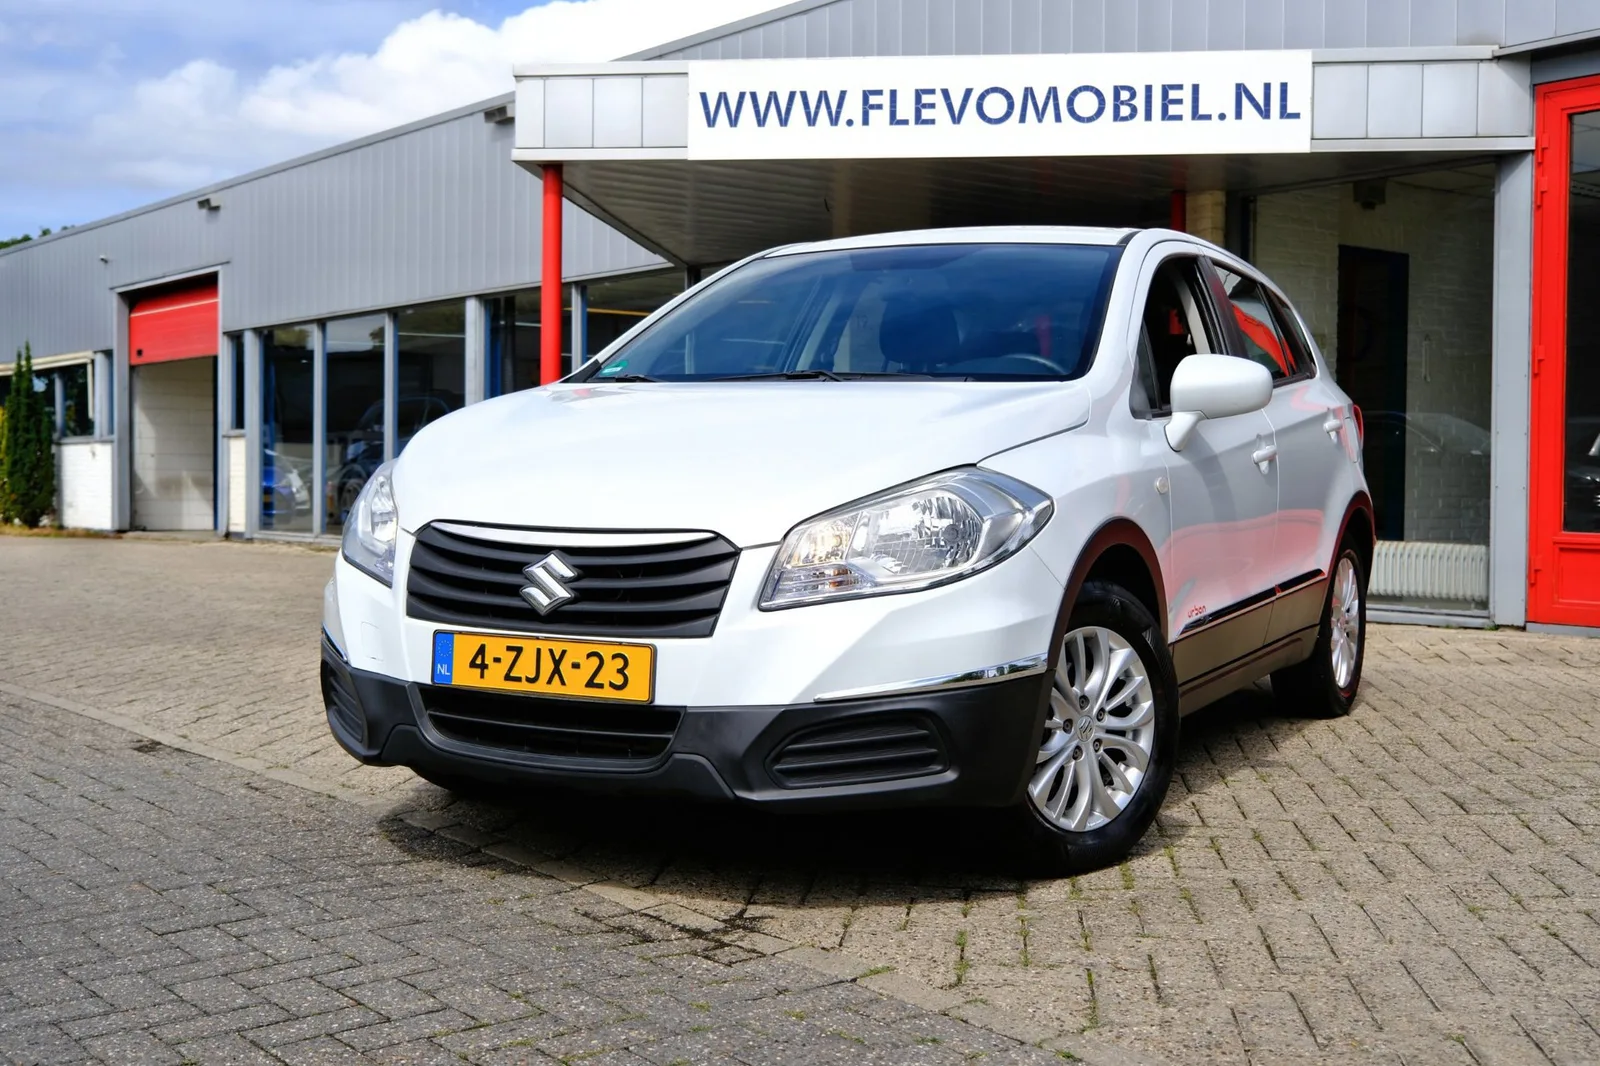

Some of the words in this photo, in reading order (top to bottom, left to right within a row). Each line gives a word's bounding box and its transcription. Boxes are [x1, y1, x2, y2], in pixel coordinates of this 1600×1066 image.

[699, 82, 1301, 128] WWW.FLEVOMOBIEL.NL
[1187, 605, 1207, 618] urban
[437, 664, 450, 675] NL
[469, 643, 630, 691] 4-ZJX-23
